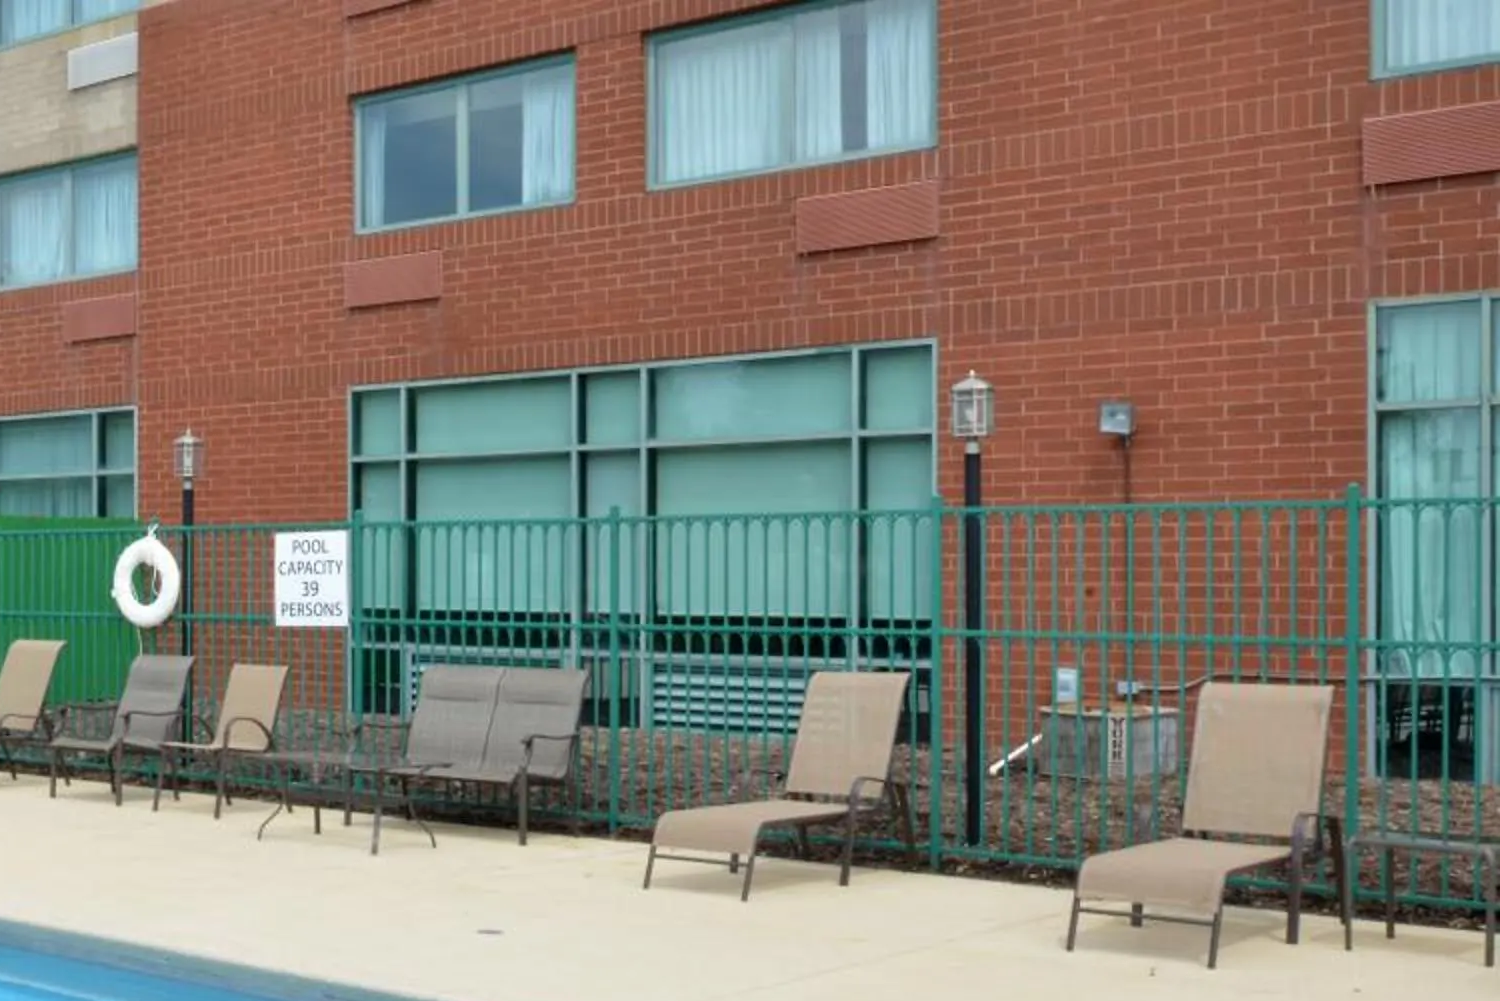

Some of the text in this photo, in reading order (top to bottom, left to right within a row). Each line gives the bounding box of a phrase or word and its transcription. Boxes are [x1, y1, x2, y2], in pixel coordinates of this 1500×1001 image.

[292, 540, 328, 553] POOL
[278, 560, 343, 576] CAPACITY
[301, 582, 319, 596] 39
[281, 602, 343, 617] PERSONS
